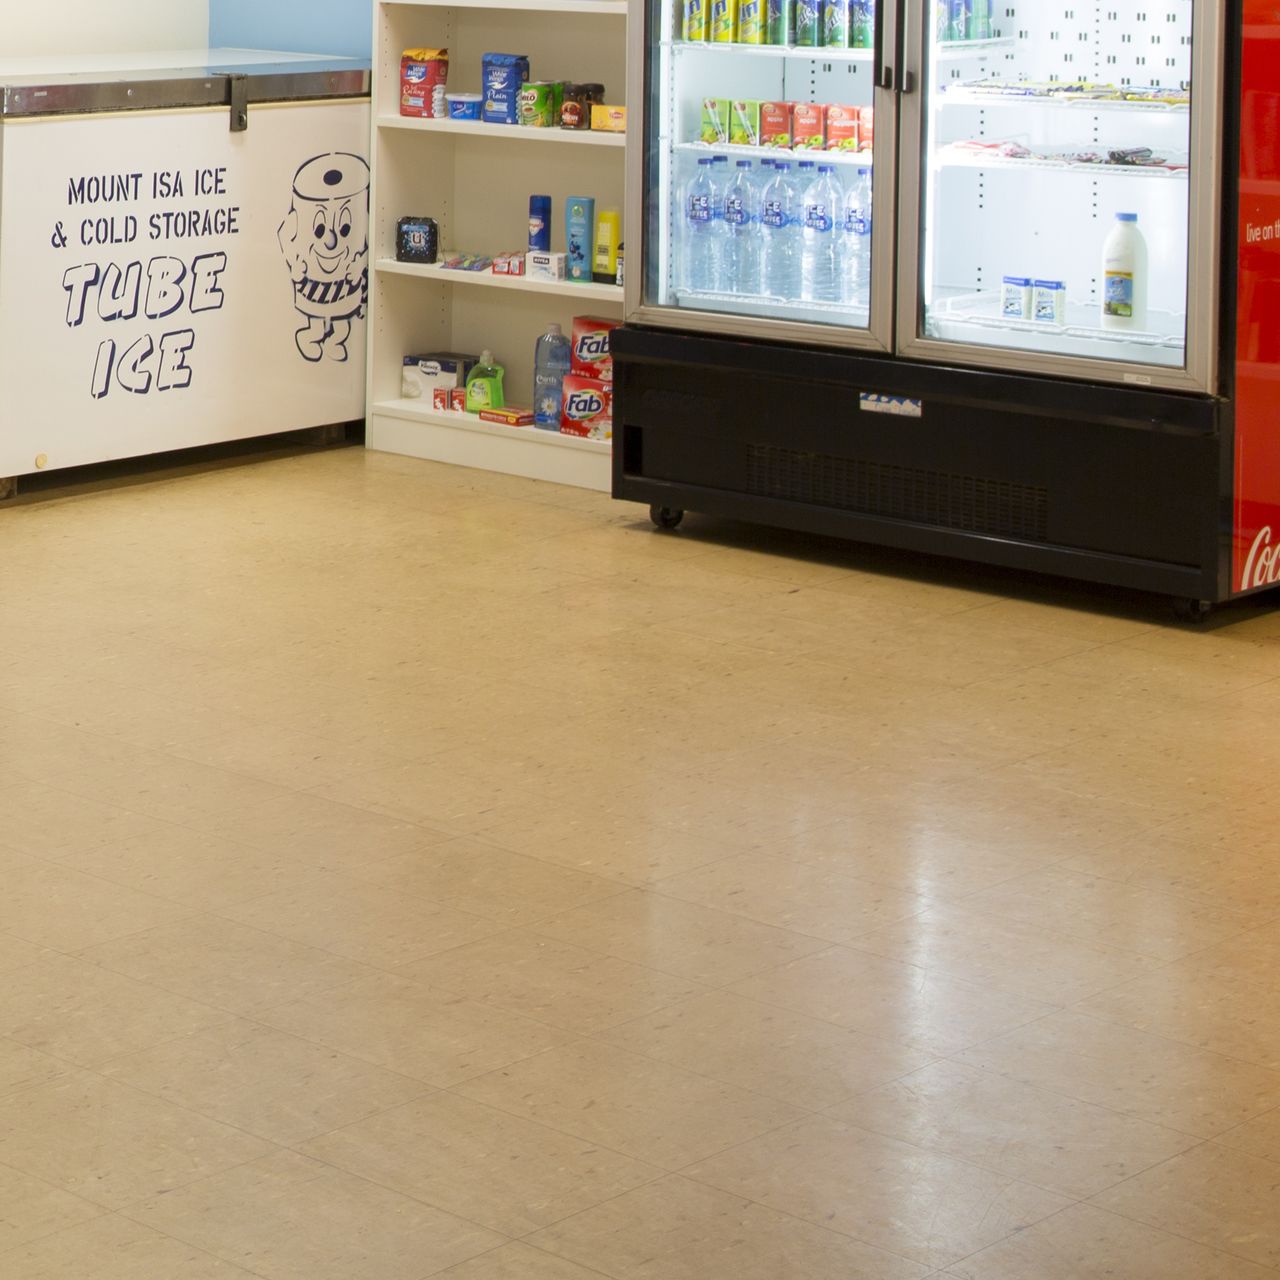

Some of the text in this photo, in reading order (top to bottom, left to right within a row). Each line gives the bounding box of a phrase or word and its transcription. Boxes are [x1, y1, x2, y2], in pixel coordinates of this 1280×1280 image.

[487, 89, 507, 100] Plain
[67, 167, 227, 206] MOUNT ISA ICE
[691, 195, 708, 211] ICE
[724, 198, 742, 213] ICE
[763, 200, 781, 216] ICE
[806, 204, 825, 220] ICE
[845, 206, 864, 222] ICE
[50, 206, 240, 249] & COLD STORAGE
[1246, 222, 1262, 243] live
[1262, 224, 1274, 241] on
[533, 257, 550, 265] NIVEA
[62, 250, 228, 328] TUBE
[577, 334, 609, 355] Fab
[90, 327, 195, 400] ICE
[567, 393, 603, 414] Fab
